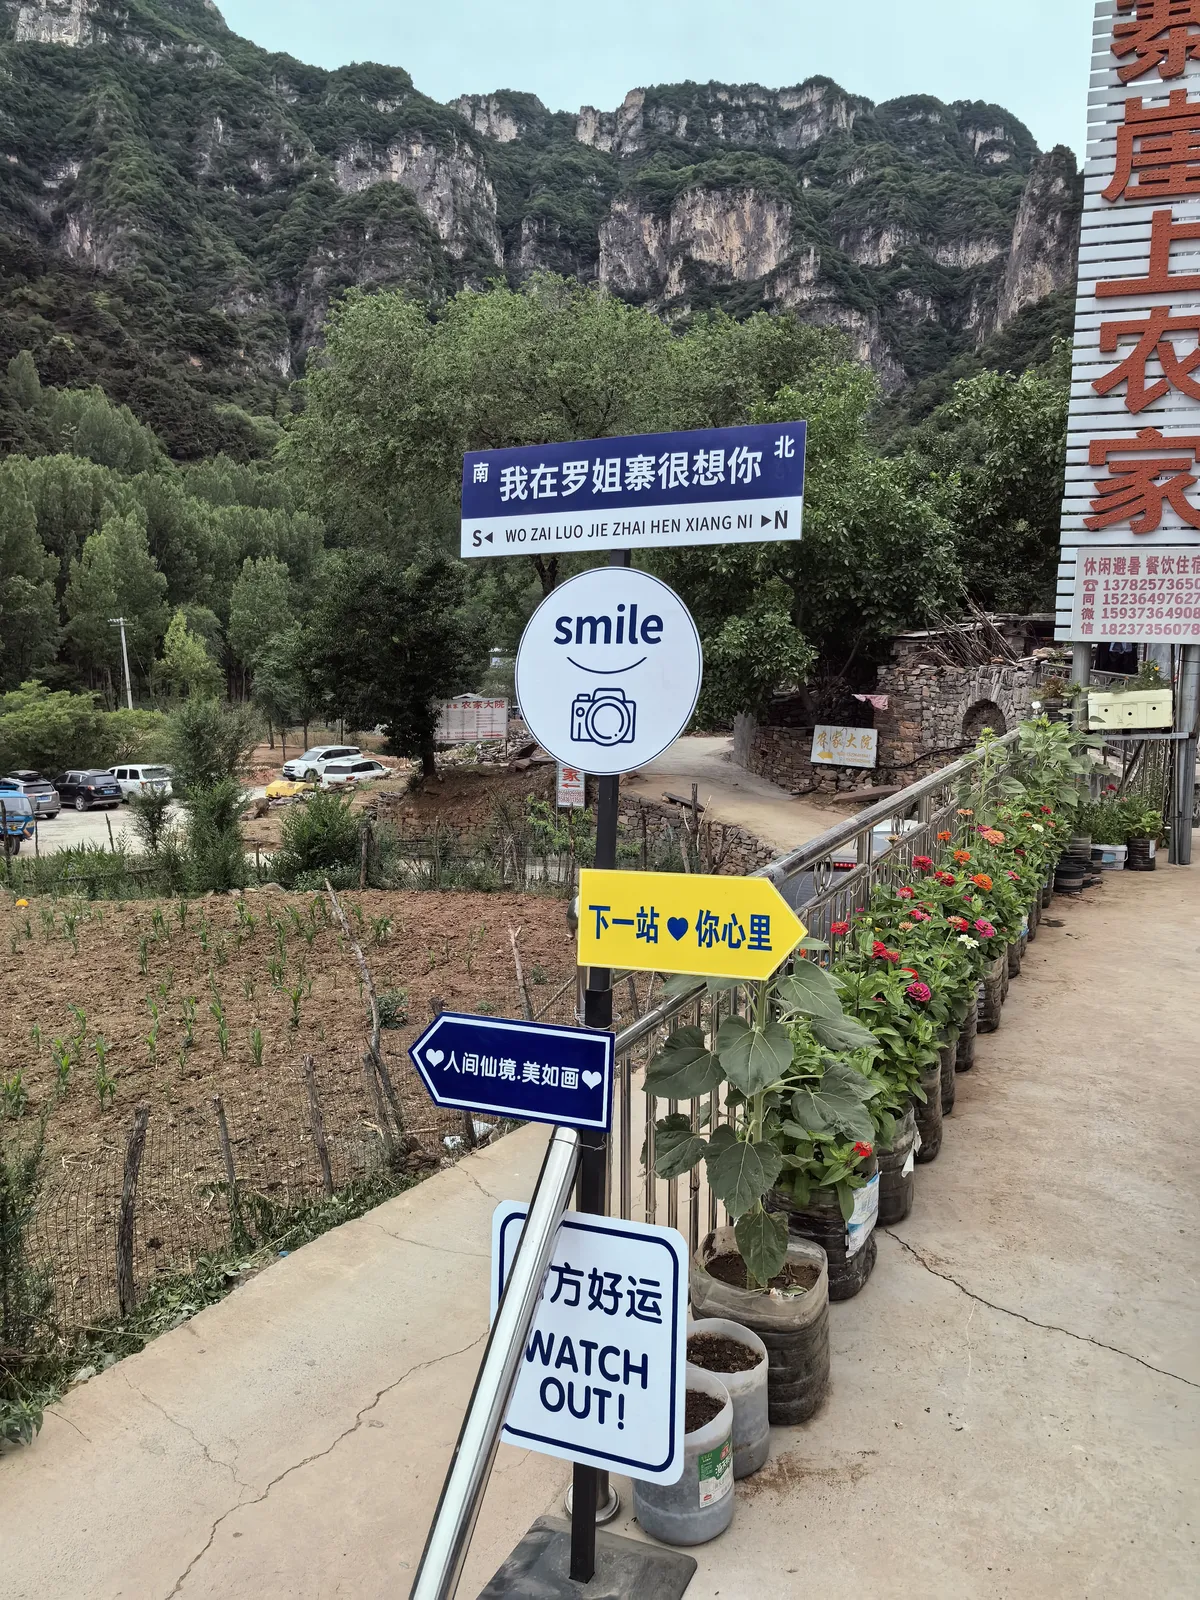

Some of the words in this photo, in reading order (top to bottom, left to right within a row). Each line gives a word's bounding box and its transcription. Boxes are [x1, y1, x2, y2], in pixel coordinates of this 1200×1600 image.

[774, 434, 795, 460] 北
[472, 461, 490, 484] 南
[499, 445, 763, 502] 我在罗姐寨很想你
[505, 528, 527, 543] WO
[530, 526, 552, 542] ZAI
[555, 524, 584, 540] LUO
[587, 522, 608, 538] JIE
[612, 520, 646, 536] ZHAI
[650, 518, 682, 534] HEN
[685, 515, 733, 532] XIANG
[737, 514, 753, 529] NI
[774, 510, 789, 530] N
[472, 529, 483, 547] S
[1083, 556, 1141, 576] 休闲避暑
[1102, 592, 1200, 605] 15236497627
[553, 604, 664, 645] smile
[1101, 607, 1200, 619] 15937364908
[1100, 623, 1200, 635] 18237356078
[461, 700, 505, 710] 农家大院
[562, 768, 580, 782] 家
[588, 904, 660, 944] 下一站
[694, 908, 773, 952] 你心里
[541, 1262, 663, 1325] 方好运
[526, 1329, 649, 1390] WATCH
[539, 1376, 625, 1430] OUT!
